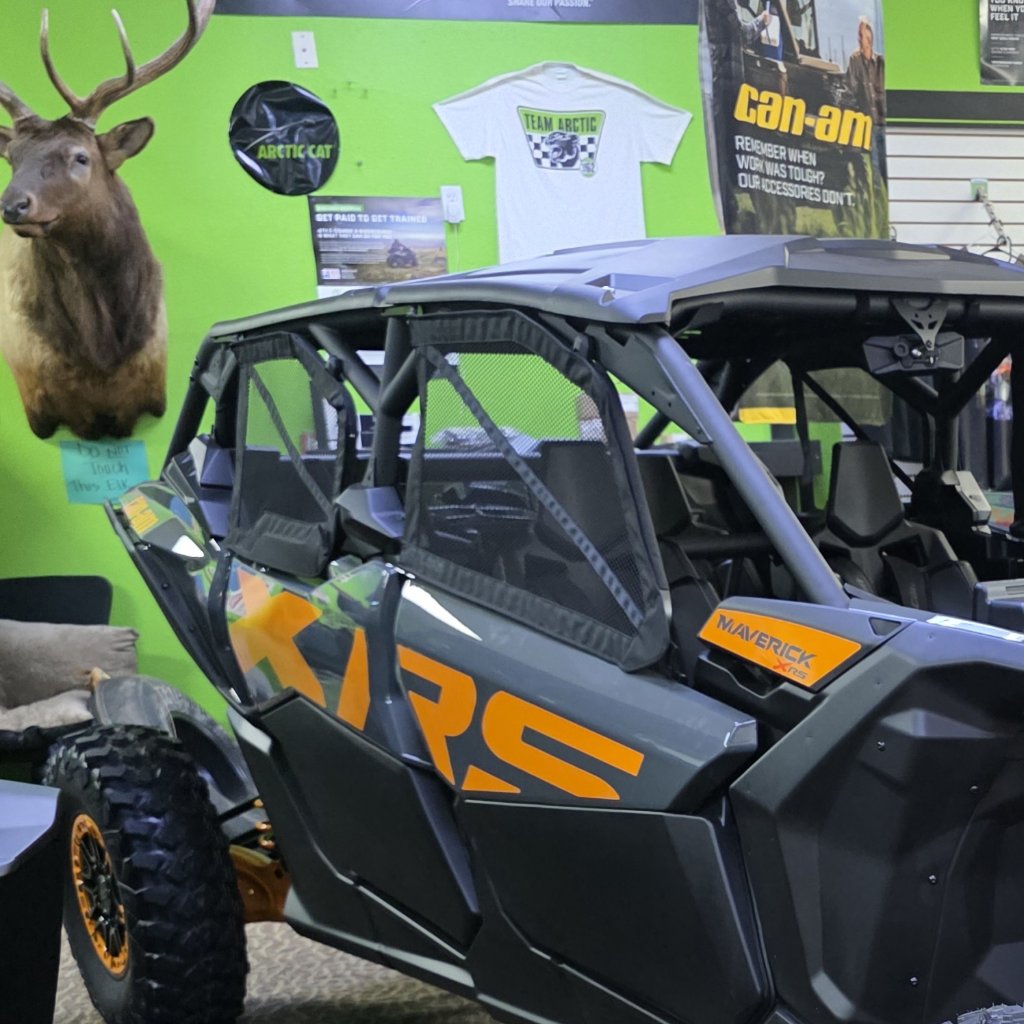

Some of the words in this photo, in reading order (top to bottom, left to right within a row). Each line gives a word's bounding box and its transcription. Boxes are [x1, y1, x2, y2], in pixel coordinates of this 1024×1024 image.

[990, 5, 1014, 13] WHEN
[990, 13, 1010, 21] FEEL
[1011, 13, 1019, 22] IT
[524, 113, 554, 132] TEAM
[558, 116, 597, 133] ARCTIC
[734, 83, 873, 151] can-am
[257, 144, 305, 159] ARCTIC
[307, 144, 333, 159] CAT
[734, 135, 787, 160] REMEMBER
[788, 148, 817, 166] WHEN
[735, 154, 764, 174] WORK
[764, 160, 787, 179] WAS
[788, 165, 826, 185] TOUGH?
[738, 173, 761, 190] OUR
[761, 178, 821, 203] ACCESSORIES
[822, 189, 856, 207] DON'T.
[315, 213, 333, 222] GET
[334, 214, 356, 222] PAID
[357, 214, 370, 223] TO
[371, 214, 388, 223] GET
[389, 214, 428, 224] TRAINED
[716, 614, 817, 669] MAVERICK
